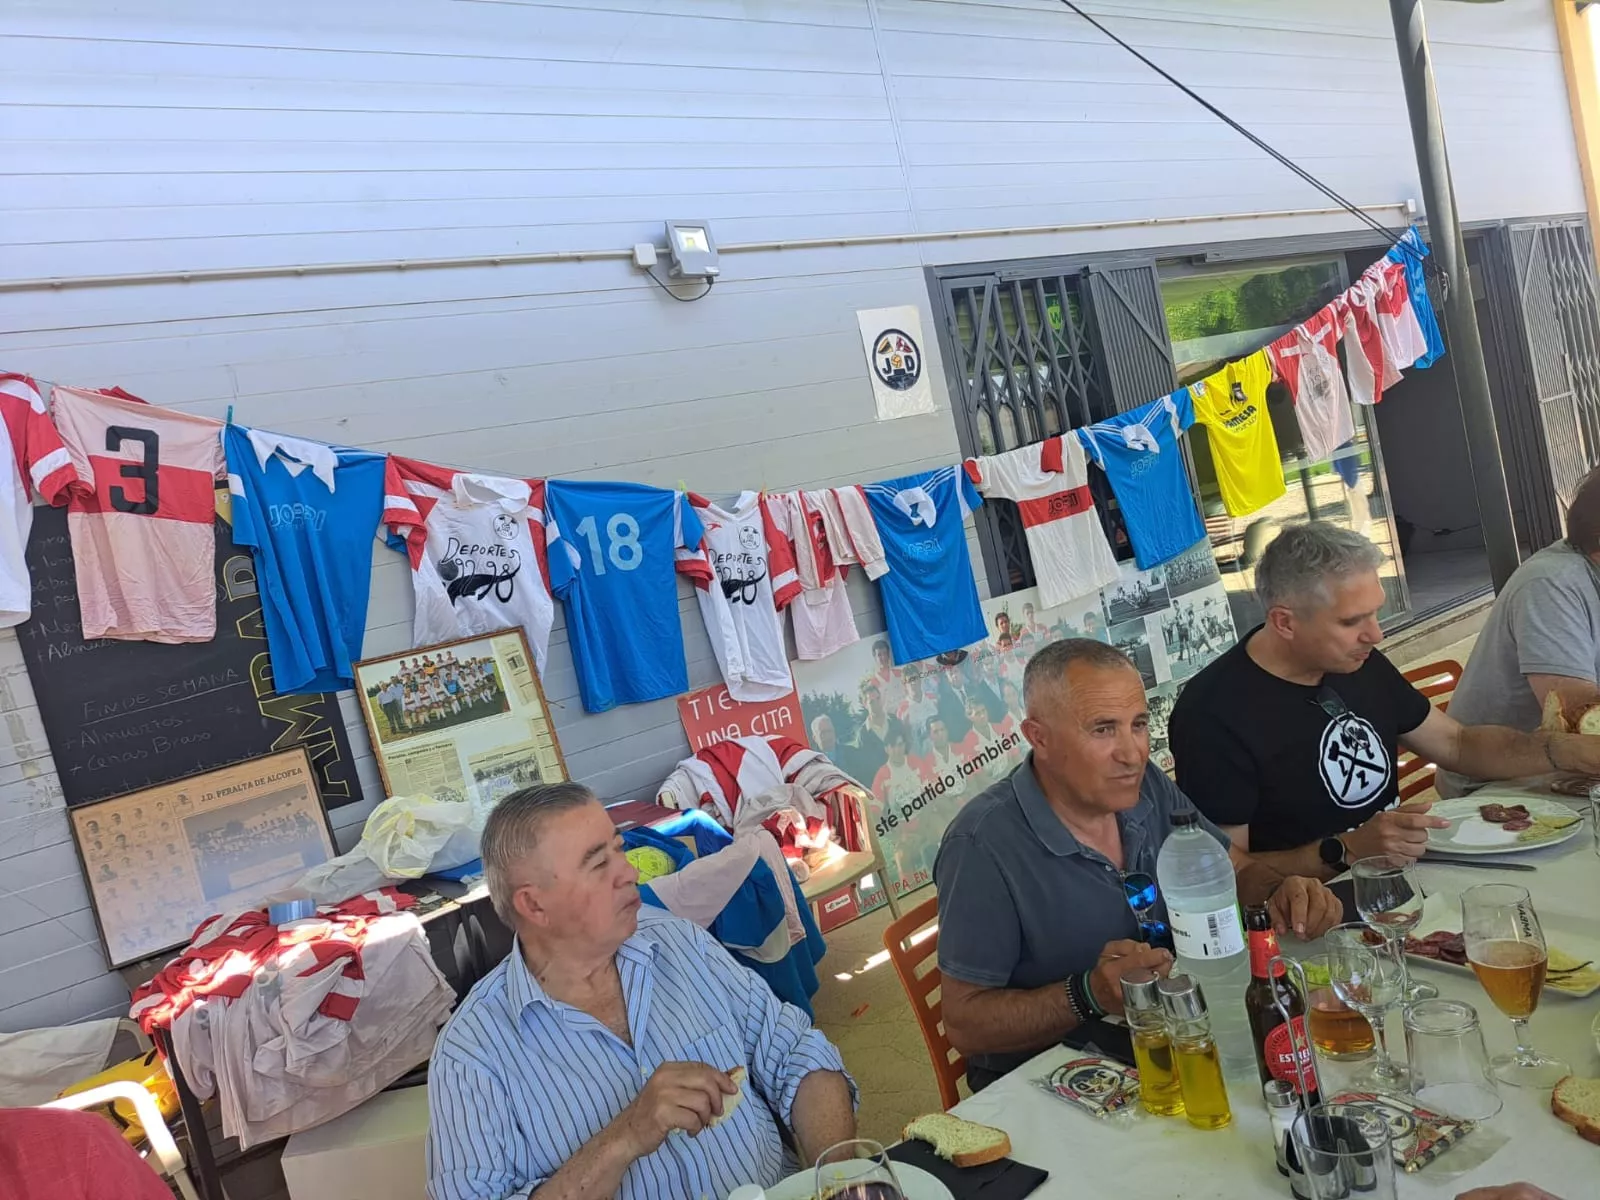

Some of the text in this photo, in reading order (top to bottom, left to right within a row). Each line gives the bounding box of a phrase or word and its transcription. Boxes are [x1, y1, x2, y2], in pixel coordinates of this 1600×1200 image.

[106, 425, 159, 515] 3
[441, 537, 521, 564] DEPORTES
[575, 512, 643, 576] 18
[697, 706, 792, 749] UNA CITA
[215, 781, 254, 799] PERALTA
[254, 777, 266, 787] DE
[267, 767, 303, 784] ALCOFEA
[875, 731, 1021, 838] sté partido también
